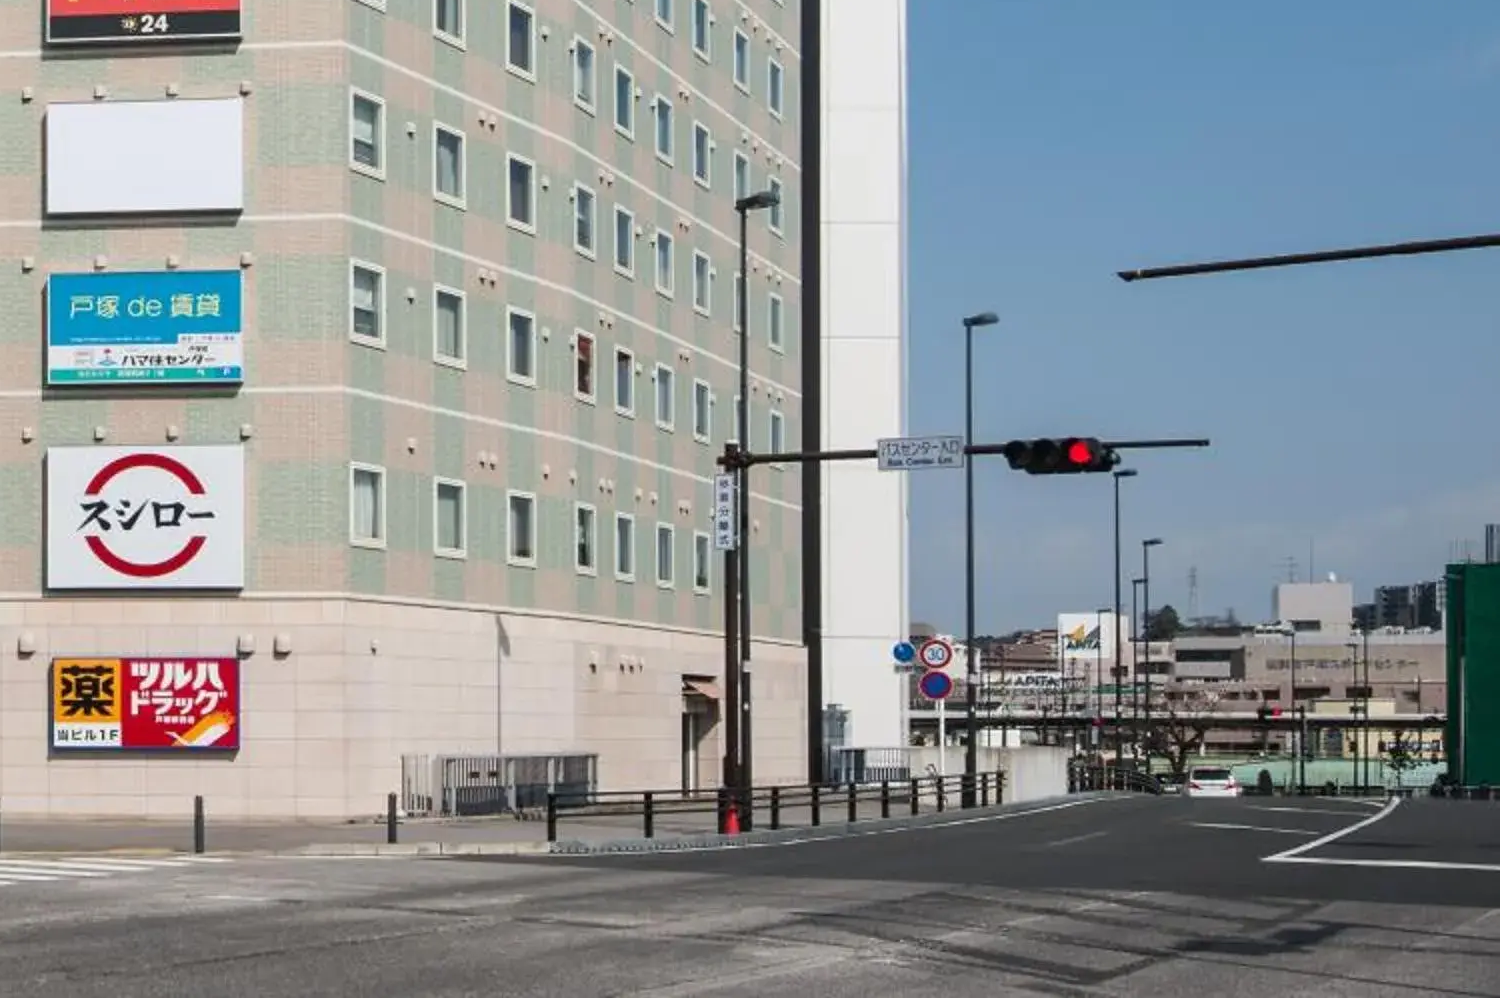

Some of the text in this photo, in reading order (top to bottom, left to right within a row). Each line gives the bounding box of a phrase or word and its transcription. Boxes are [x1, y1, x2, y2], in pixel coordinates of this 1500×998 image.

[140, 14, 170, 33] 24
[69, 294, 120, 319] 戸塚
[127, 296, 163, 317] de
[76, 499, 216, 531] スシロー
[927, 647, 945, 661] 30
[130, 662, 224, 690] ツルハ
[61, 665, 115, 716] 薬
[131, 689, 227, 715] ドラッグ
[57, 728, 118, 741] 当ビル1F
